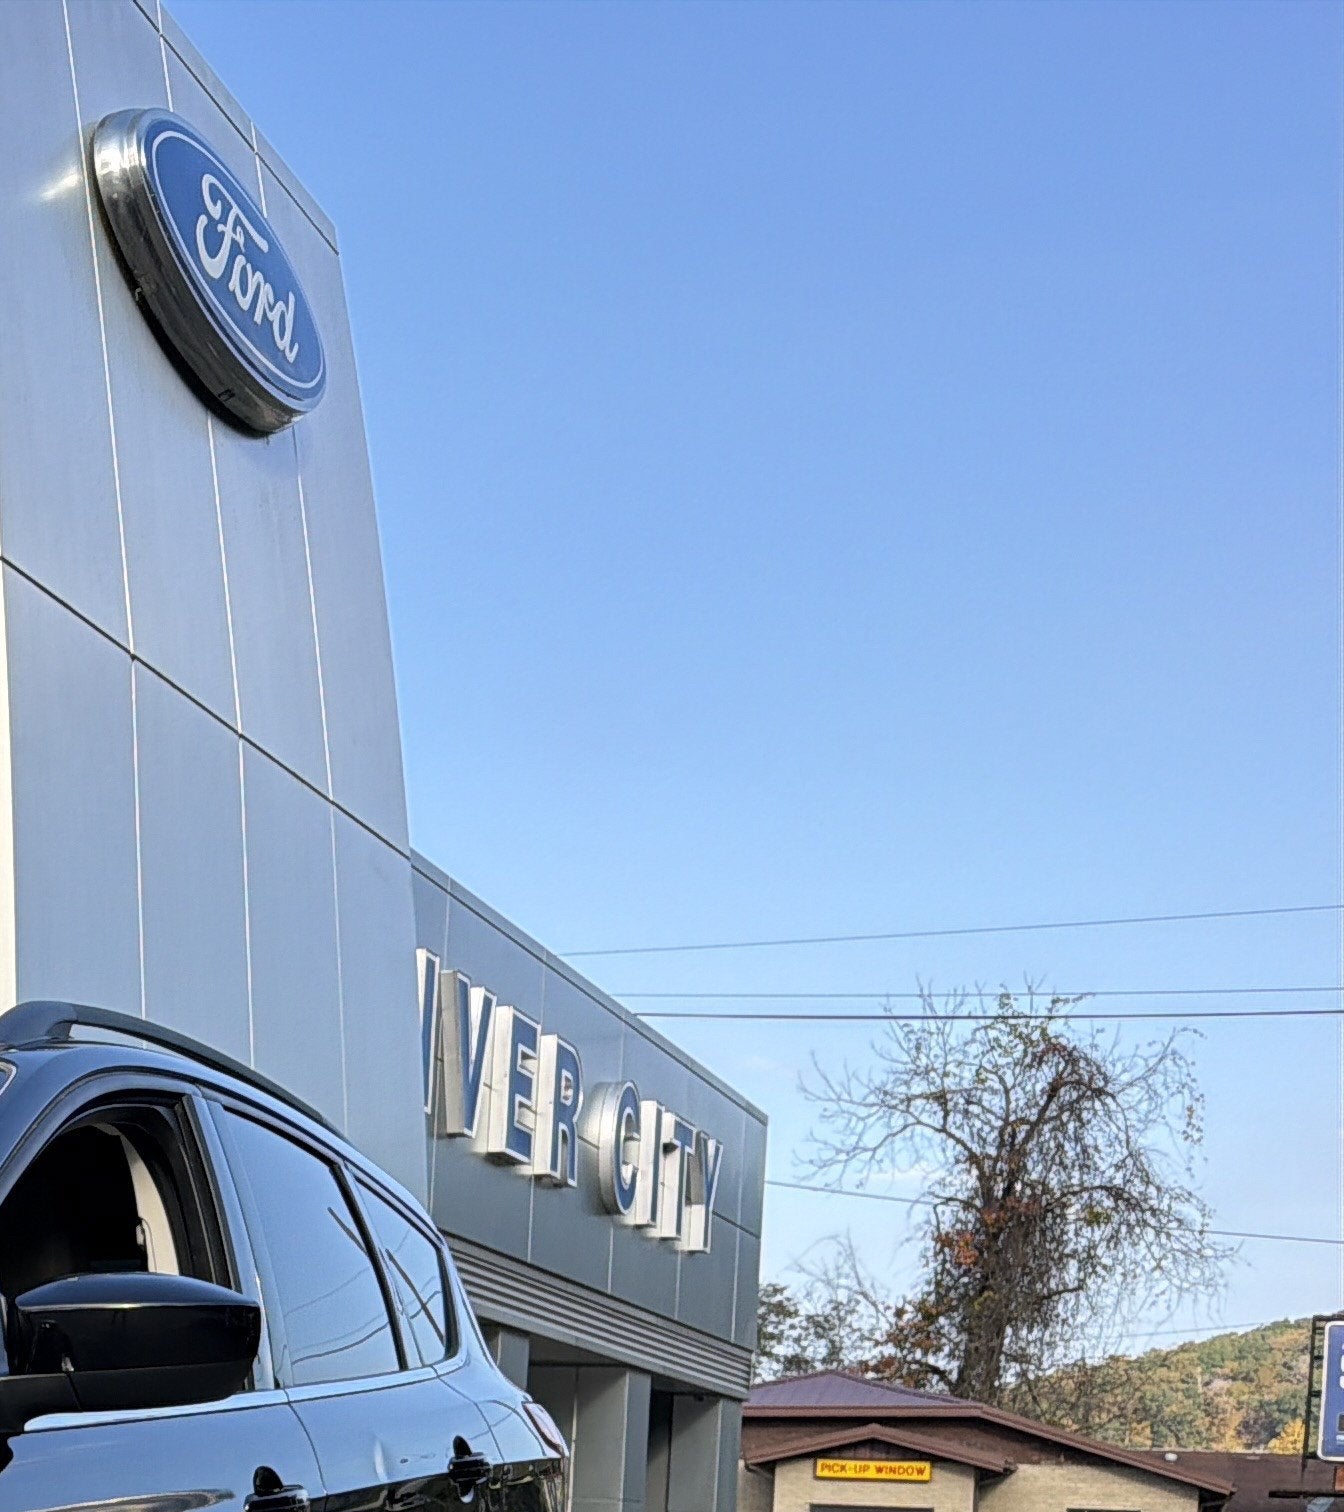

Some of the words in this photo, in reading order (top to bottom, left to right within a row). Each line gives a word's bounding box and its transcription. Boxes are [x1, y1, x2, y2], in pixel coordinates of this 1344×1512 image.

[196, 173, 298, 363] Ford
[416, 947, 584, 1188] IVER
[598, 1080, 724, 1254] CITY
[820, 1461, 871, 1474] PICK-UP
[874, 1464, 927, 1477] WINDOW
